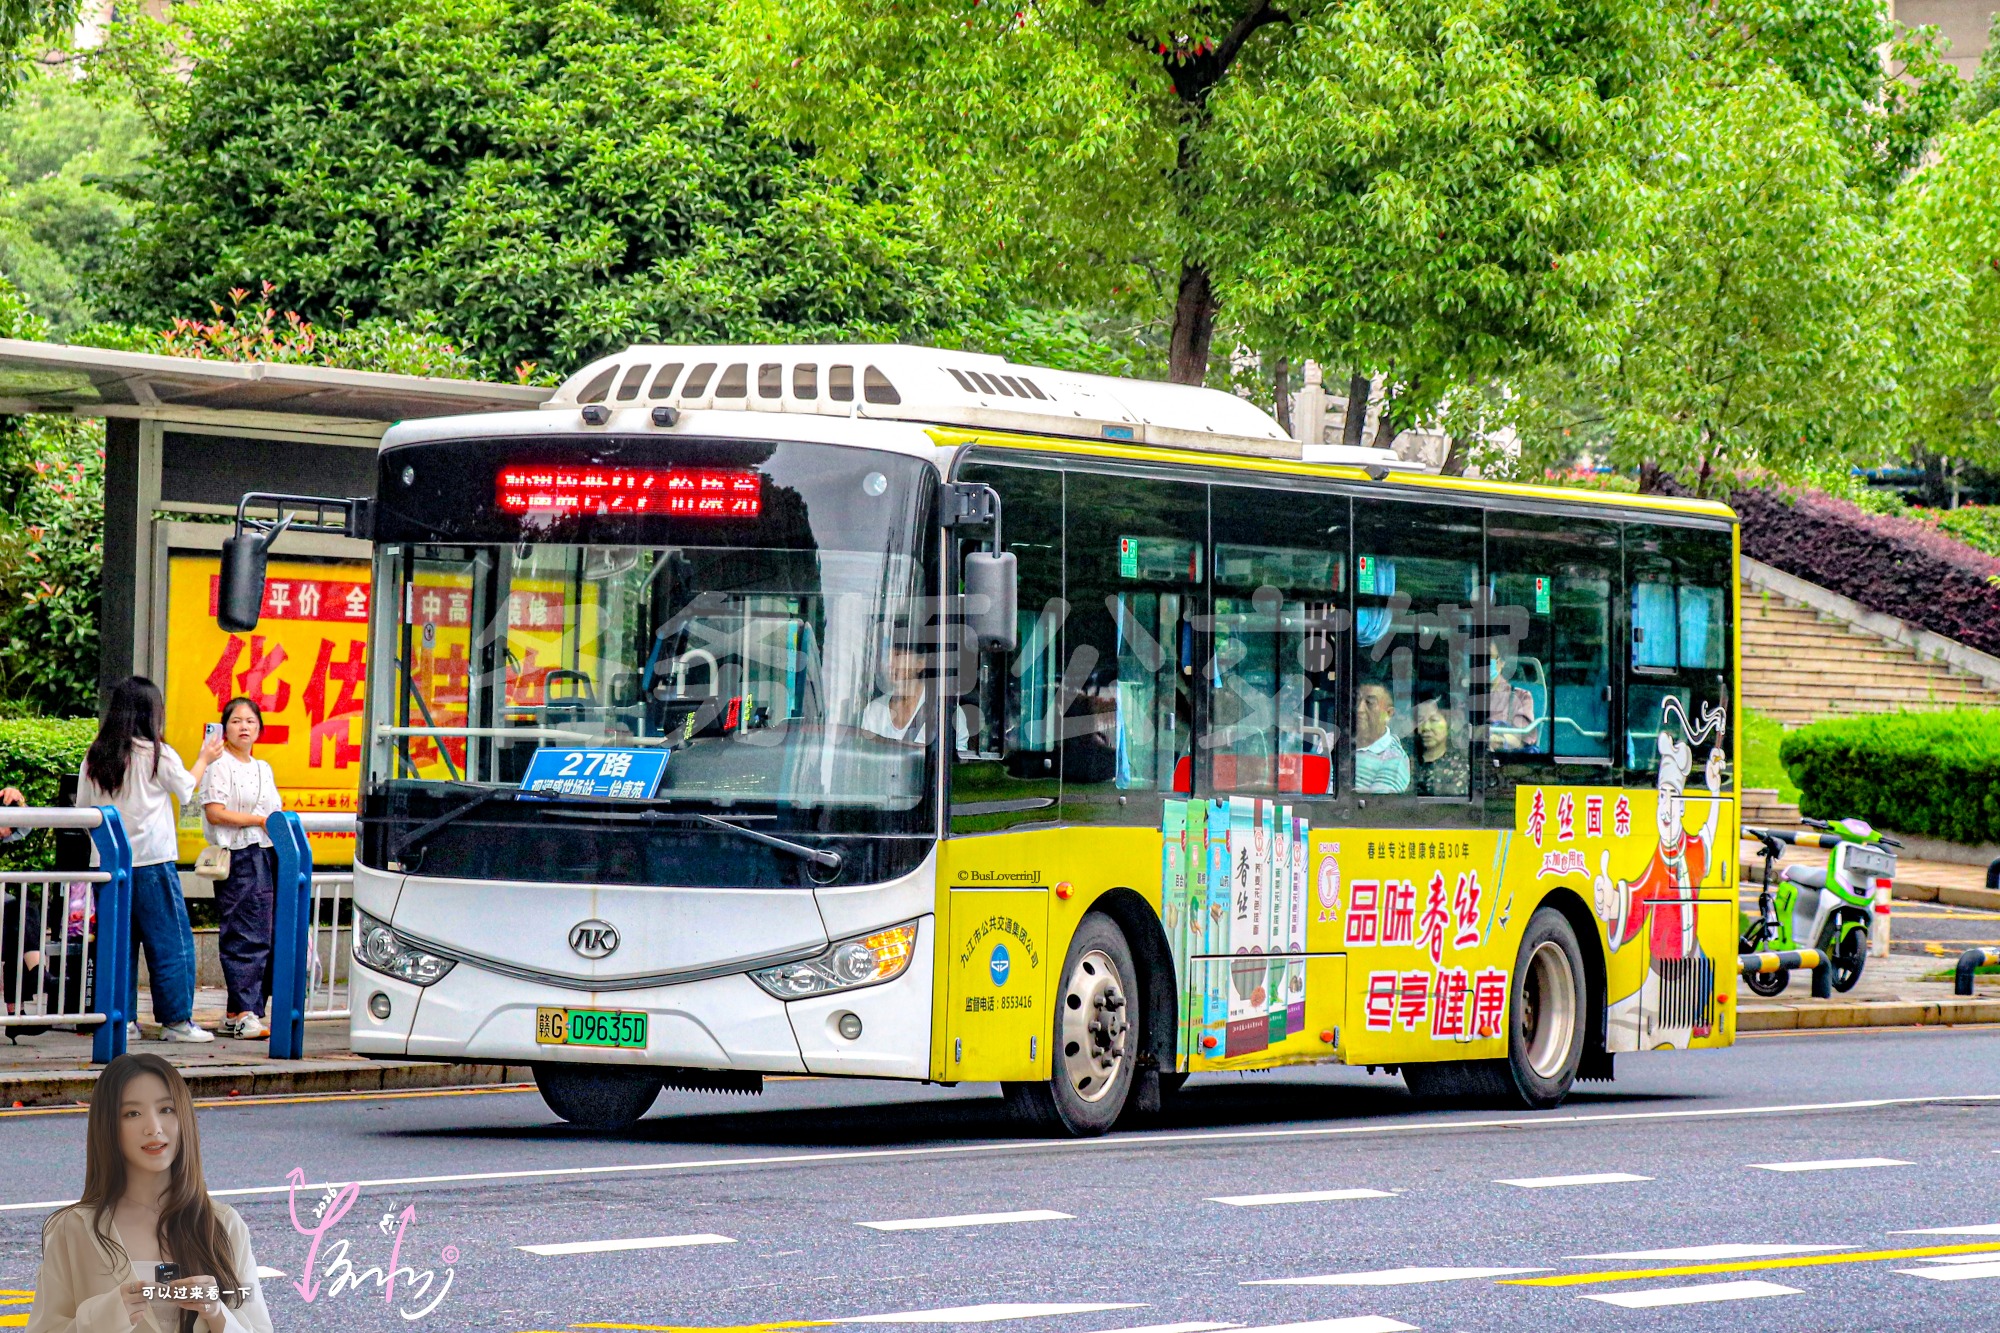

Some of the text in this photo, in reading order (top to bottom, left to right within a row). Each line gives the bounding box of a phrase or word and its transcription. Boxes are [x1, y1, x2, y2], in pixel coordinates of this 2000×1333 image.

[269, 583, 320, 616] 平价
[345, 586, 367, 617] 全
[422, 591, 468, 622] 中高
[558, 752, 633, 777] 27路
[1526, 788, 1631, 846] 春丝面条
[1368, 842, 1469, 859] 春丝专注健康食品30年
[960, 915, 1039, 969] 九江市公共交通集团公司
[1346, 875, 1480, 963] 品味春丝
[1367, 970, 1507, 1036] 尽享健康
